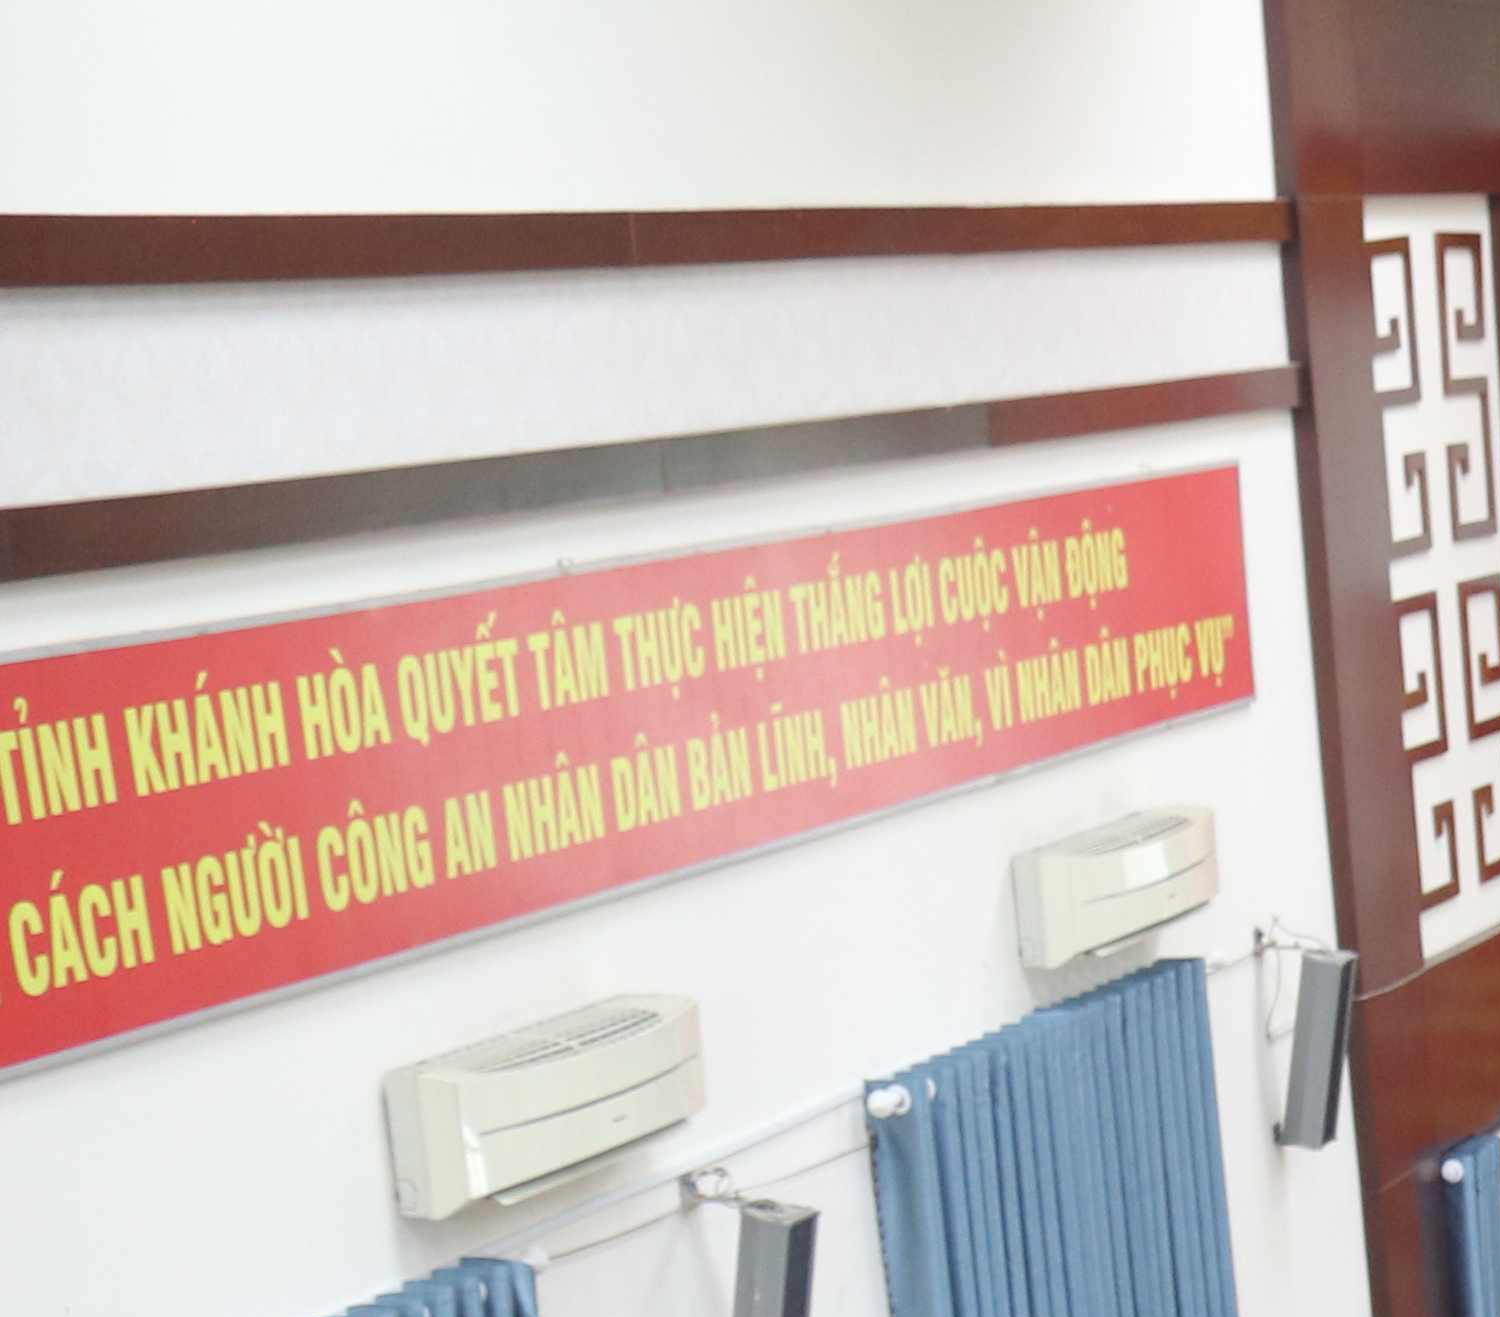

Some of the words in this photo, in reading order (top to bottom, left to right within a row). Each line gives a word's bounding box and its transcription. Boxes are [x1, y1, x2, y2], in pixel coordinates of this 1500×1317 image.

[0, 697, 117, 825] TỈNH
[125, 671, 290, 797] KHÁNH
[297, 648, 392, 761] HÒA
[397, 612, 519, 746] QUYẾT
[528, 610, 609, 709] TÂM
[614, 596, 704, 698] THỰC
[712, 576, 786, 679] HIỆN
[790, 552, 885, 653] THẮNG
[889, 557, 935, 644] LỢI
[939, 538, 1008, 630] CUỘC
[1011, 528, 1062, 620] VẬN
[1065, 519, 1129, 609] ĐỘNG
[8, 870, 155, 997] CÁCH
[162, 821, 309, 954] NGƯỜI
[317, 799, 435, 912] CÔNG
[444, 790, 496, 879] AN
[503, 751, 606, 862] NHÂN
[611, 732, 682, 832] DÂN
[686, 713, 752, 810] BẢN
[756, 702, 838, 786] LĨNH,
[839, 677, 917, 770] NHÂN
[921, 667, 983, 747] VĂN,
[985, 650, 1014, 732] VÌ
[1017, 638, 1081, 723] NHÂN
[1085, 627, 1130, 706] DÂN
[1134, 623, 1192, 699] PHỤC
